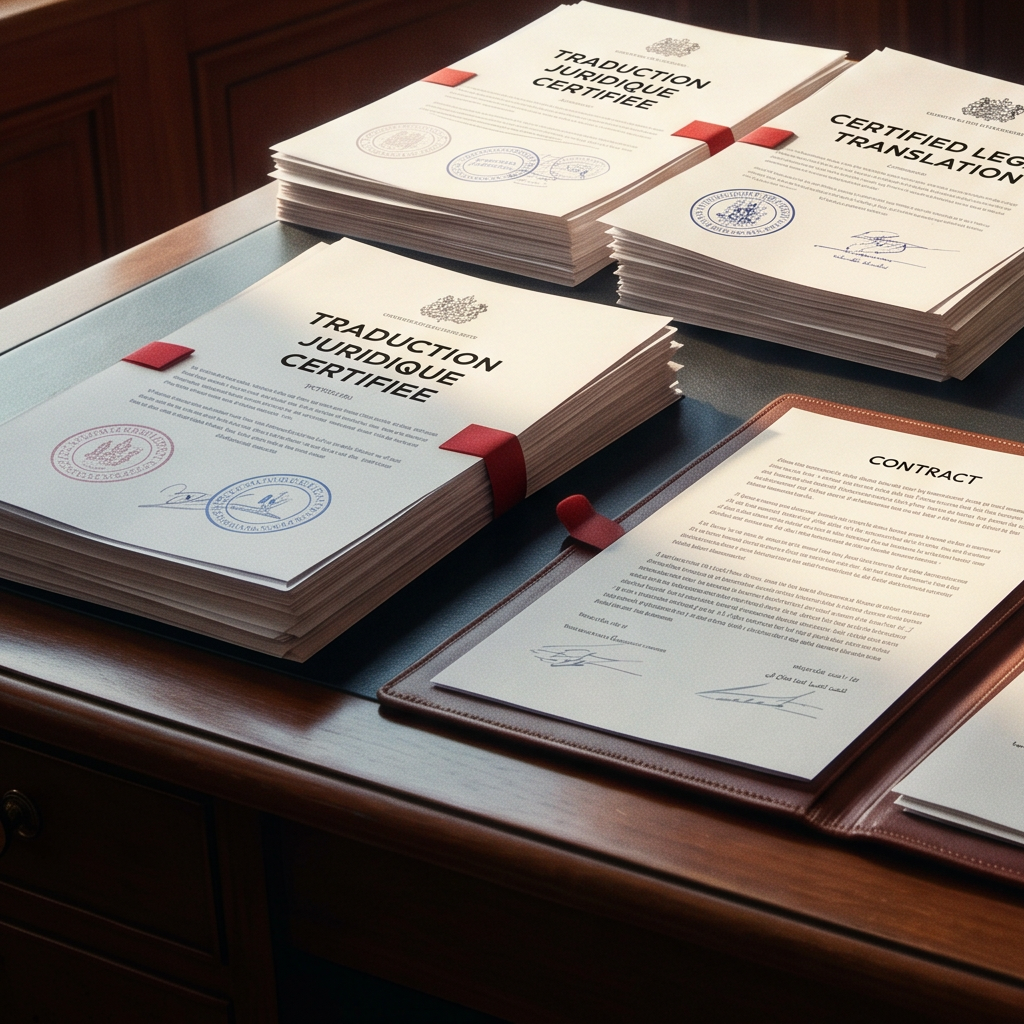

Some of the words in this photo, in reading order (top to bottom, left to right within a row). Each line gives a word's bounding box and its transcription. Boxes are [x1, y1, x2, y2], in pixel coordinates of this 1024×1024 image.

[544, 64, 680, 99] JURIDIQUE
[553, 49, 711, 90] TRADUCTION
[532, 77, 659, 110] CERTIFIEE
[830, 114, 968, 153] CERTIFIED
[834, 131, 1024, 185] TRANSLATION
[297, 336, 466, 386] JURIDIQUE
[309, 311, 503, 372] TRADUCTION
[280, 353, 439, 403] CERTIFIEE
[868, 455, 984, 485] CONTRACT
